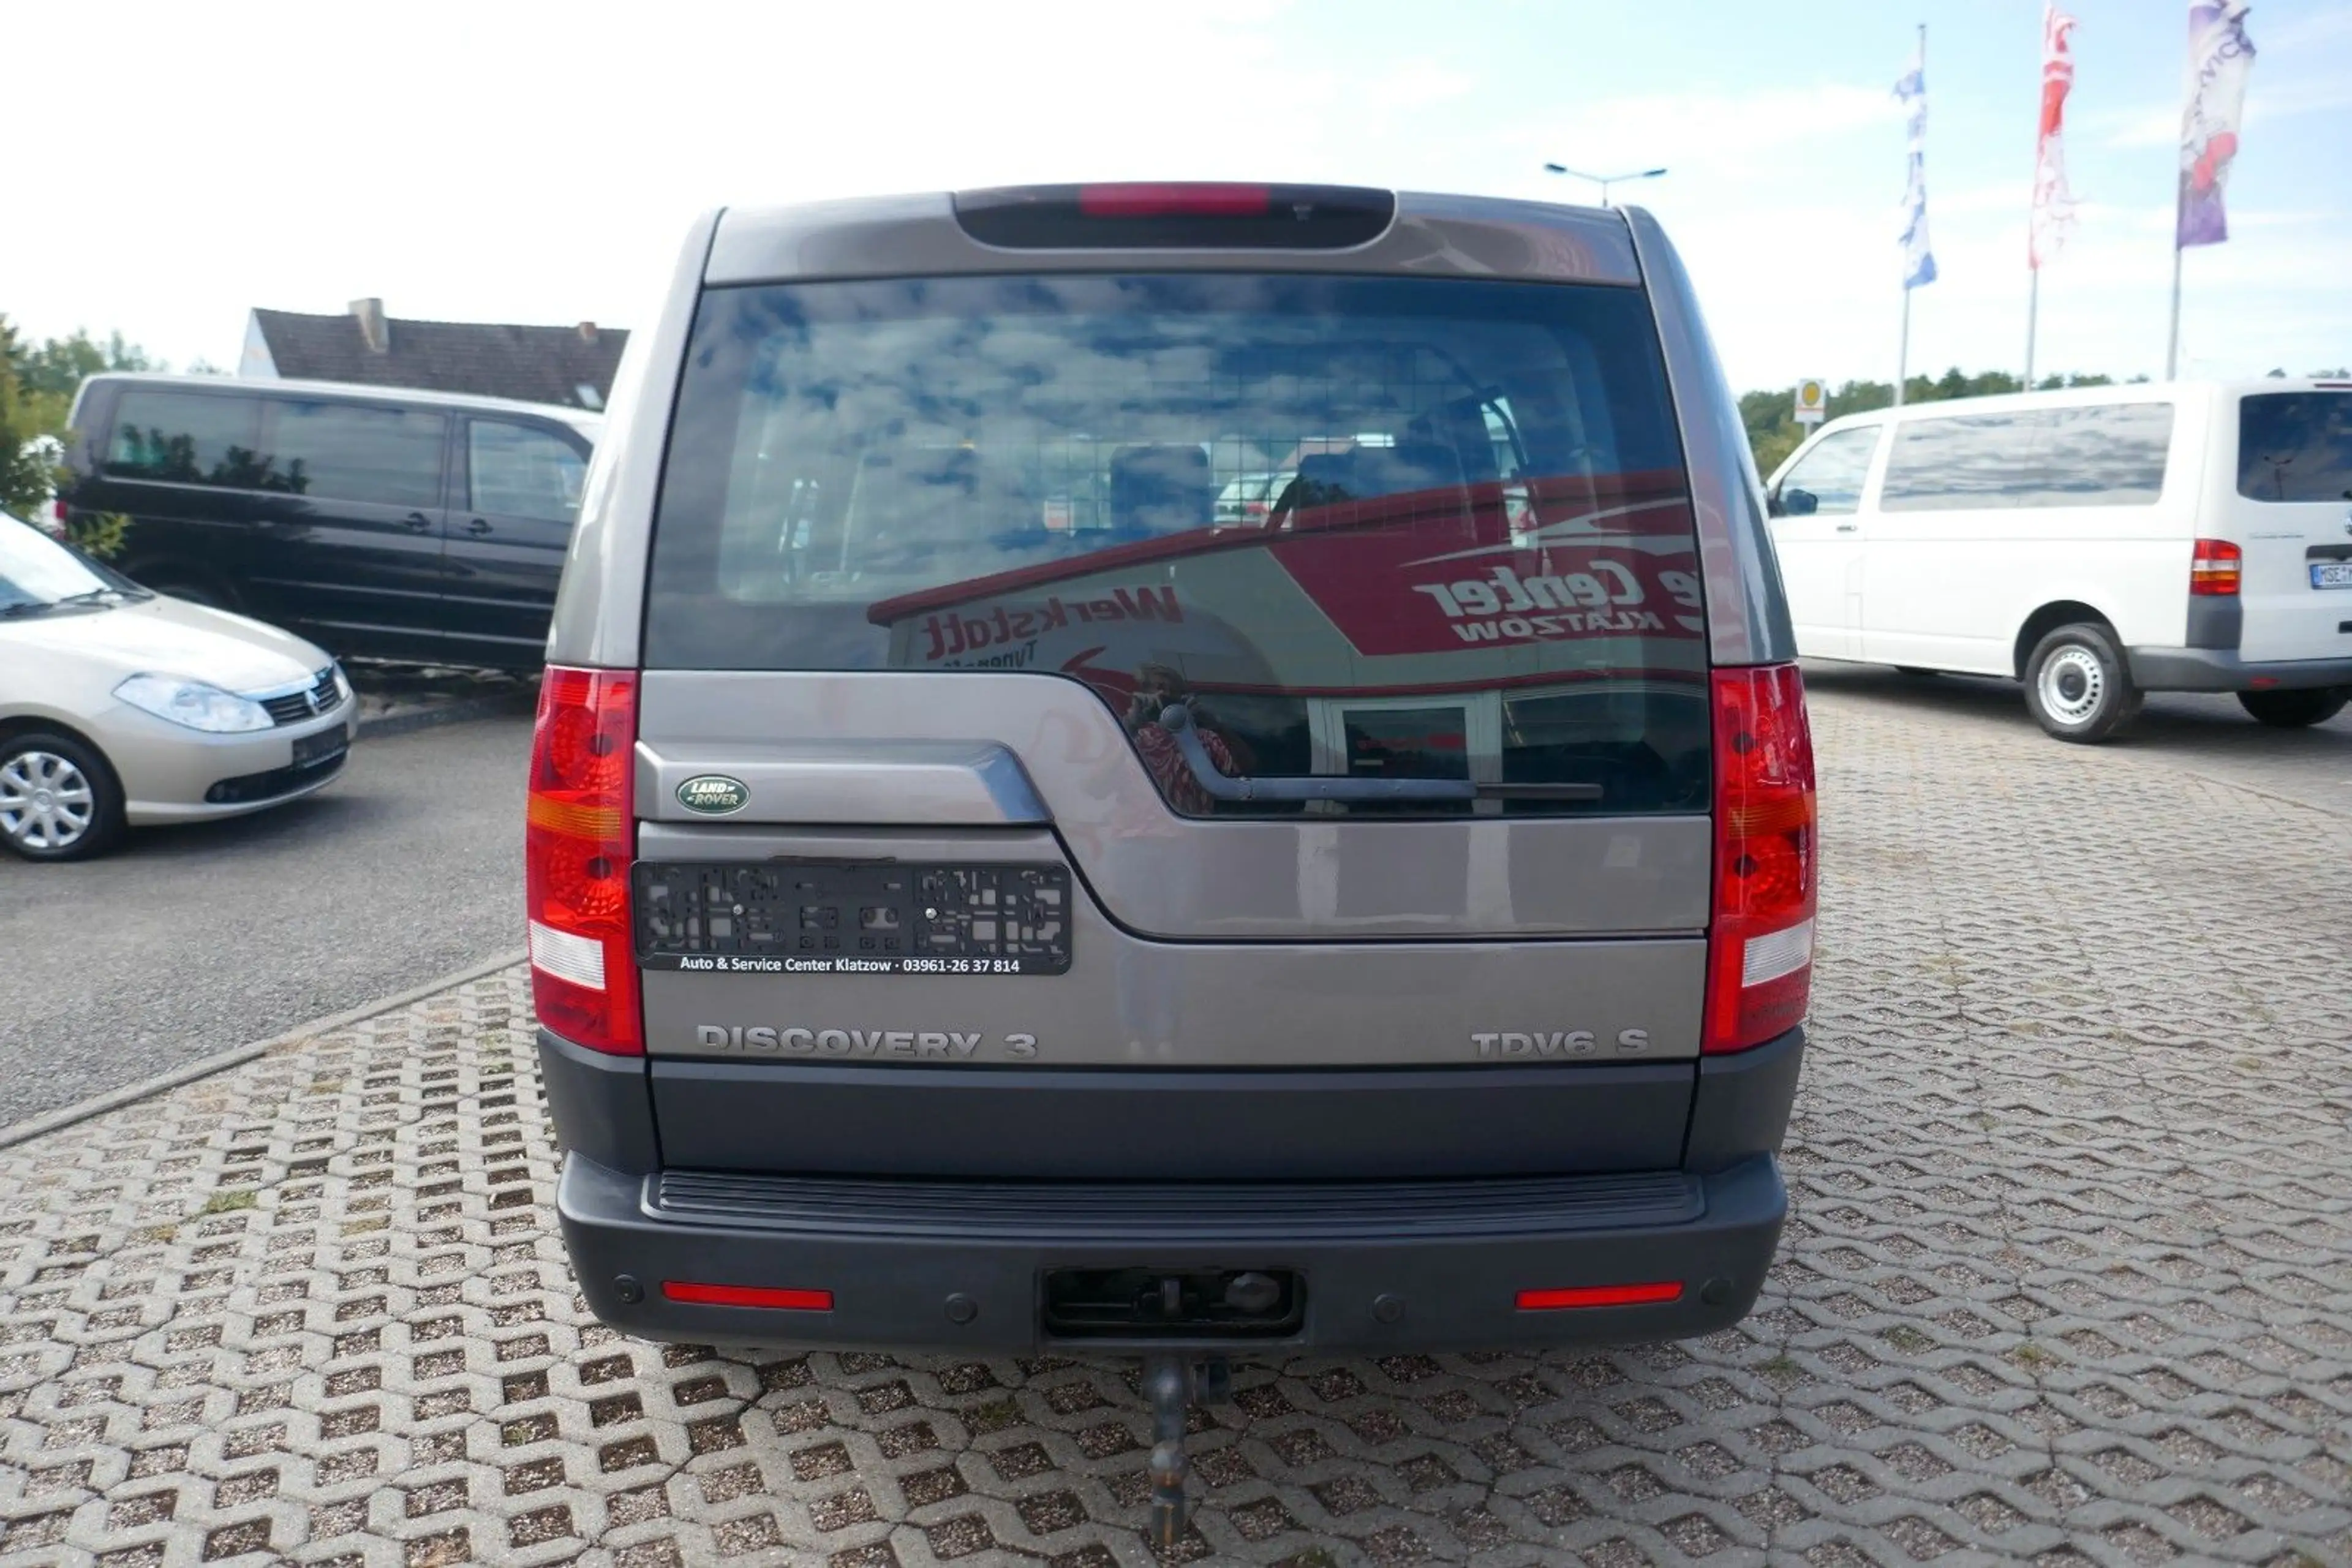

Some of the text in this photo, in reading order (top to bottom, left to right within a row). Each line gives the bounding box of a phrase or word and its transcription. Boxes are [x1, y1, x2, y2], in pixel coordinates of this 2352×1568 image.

[690, 782, 728, 793] LAND
[694, 793, 739, 805] ROVER
[680, 956, 1020, 973] Auto & Service Center Klatzow 03961-26 37 814
[697, 1024, 1039, 1058] DISCOVERY 3
[1471, 1028, 1649, 1057] TDV6 S
